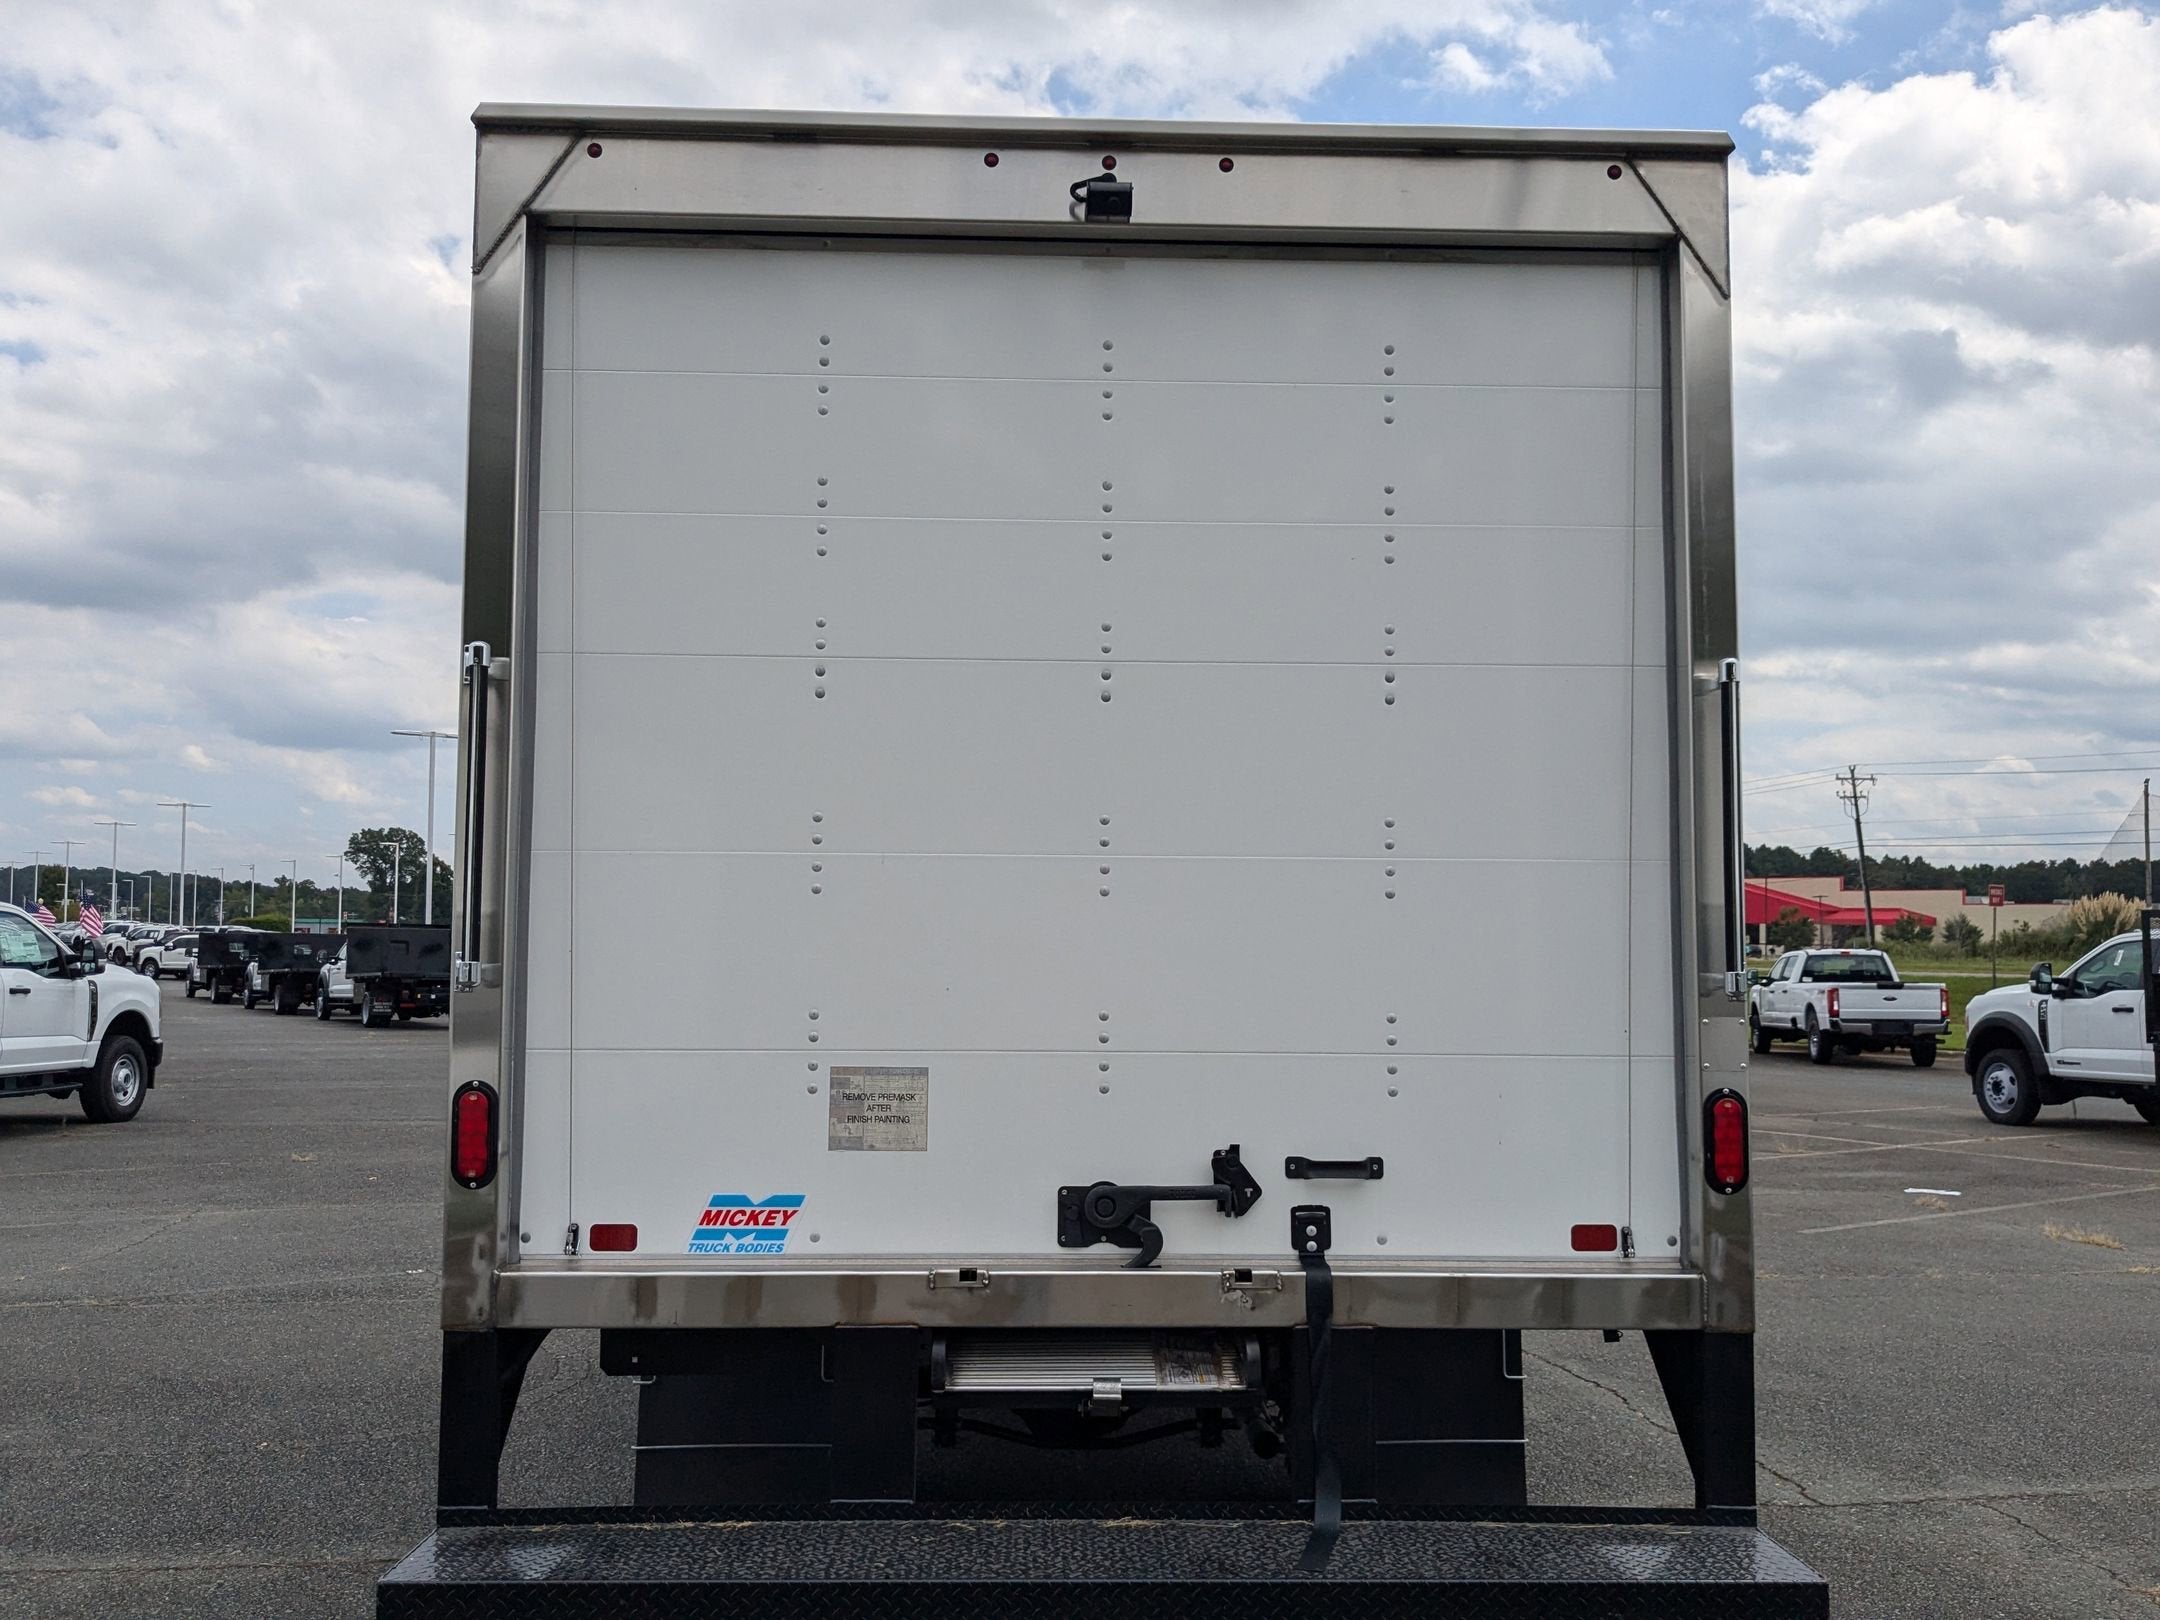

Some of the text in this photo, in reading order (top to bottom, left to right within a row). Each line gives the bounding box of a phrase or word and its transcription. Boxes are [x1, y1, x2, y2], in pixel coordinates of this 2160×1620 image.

[842, 1093, 916, 1101] REMOVE PREMASK
[866, 1104, 891, 1112] AFTER
[847, 1115, 910, 1123] FINISH PAINTING
[698, 1209, 799, 1226] MICKEY
[688, 1243, 784, 1253] TRUCK BODIES
